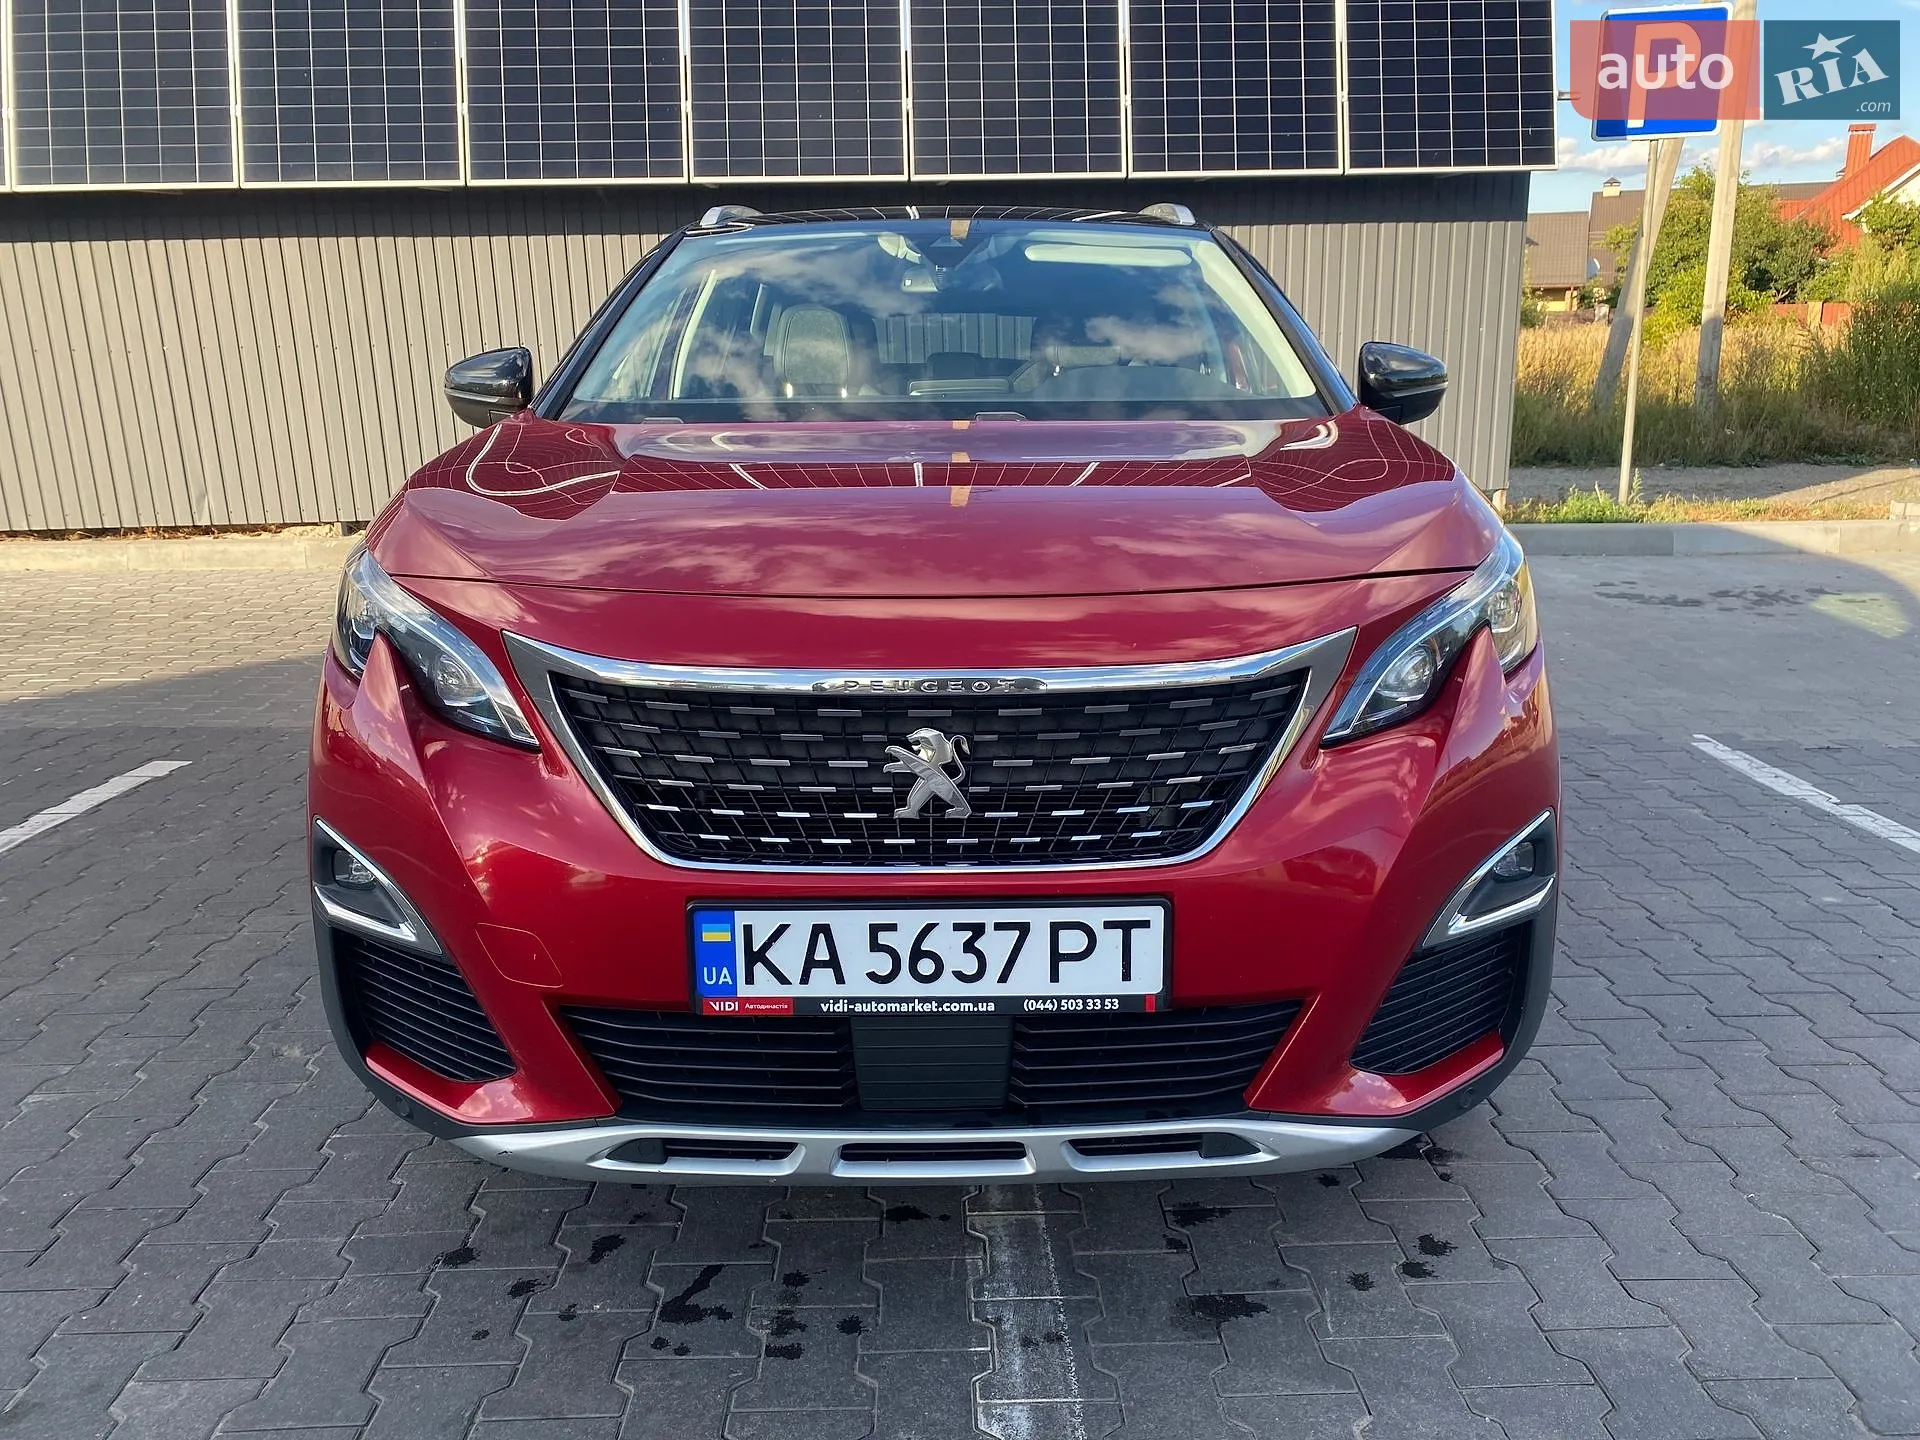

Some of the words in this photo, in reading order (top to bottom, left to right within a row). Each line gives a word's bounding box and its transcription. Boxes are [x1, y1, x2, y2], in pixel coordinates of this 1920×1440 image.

[843, 679, 1016, 693] PEUGEOT
[742, 923, 846, 986] KA
[865, 921, 1031, 985] 5637
[1049, 919, 1151, 984] PT
[703, 966, 733, 985] UA
[709, 1001, 739, 1012] VIDI
[820, 999, 996, 1013] vidi-automarket.com.ua
[1023, 998, 1058, 1011] (044)
[1060, 999, 1083, 1011] 503
[1085, 998, 1101, 1010] 33
[1103, 998, 1120, 1010] 53
